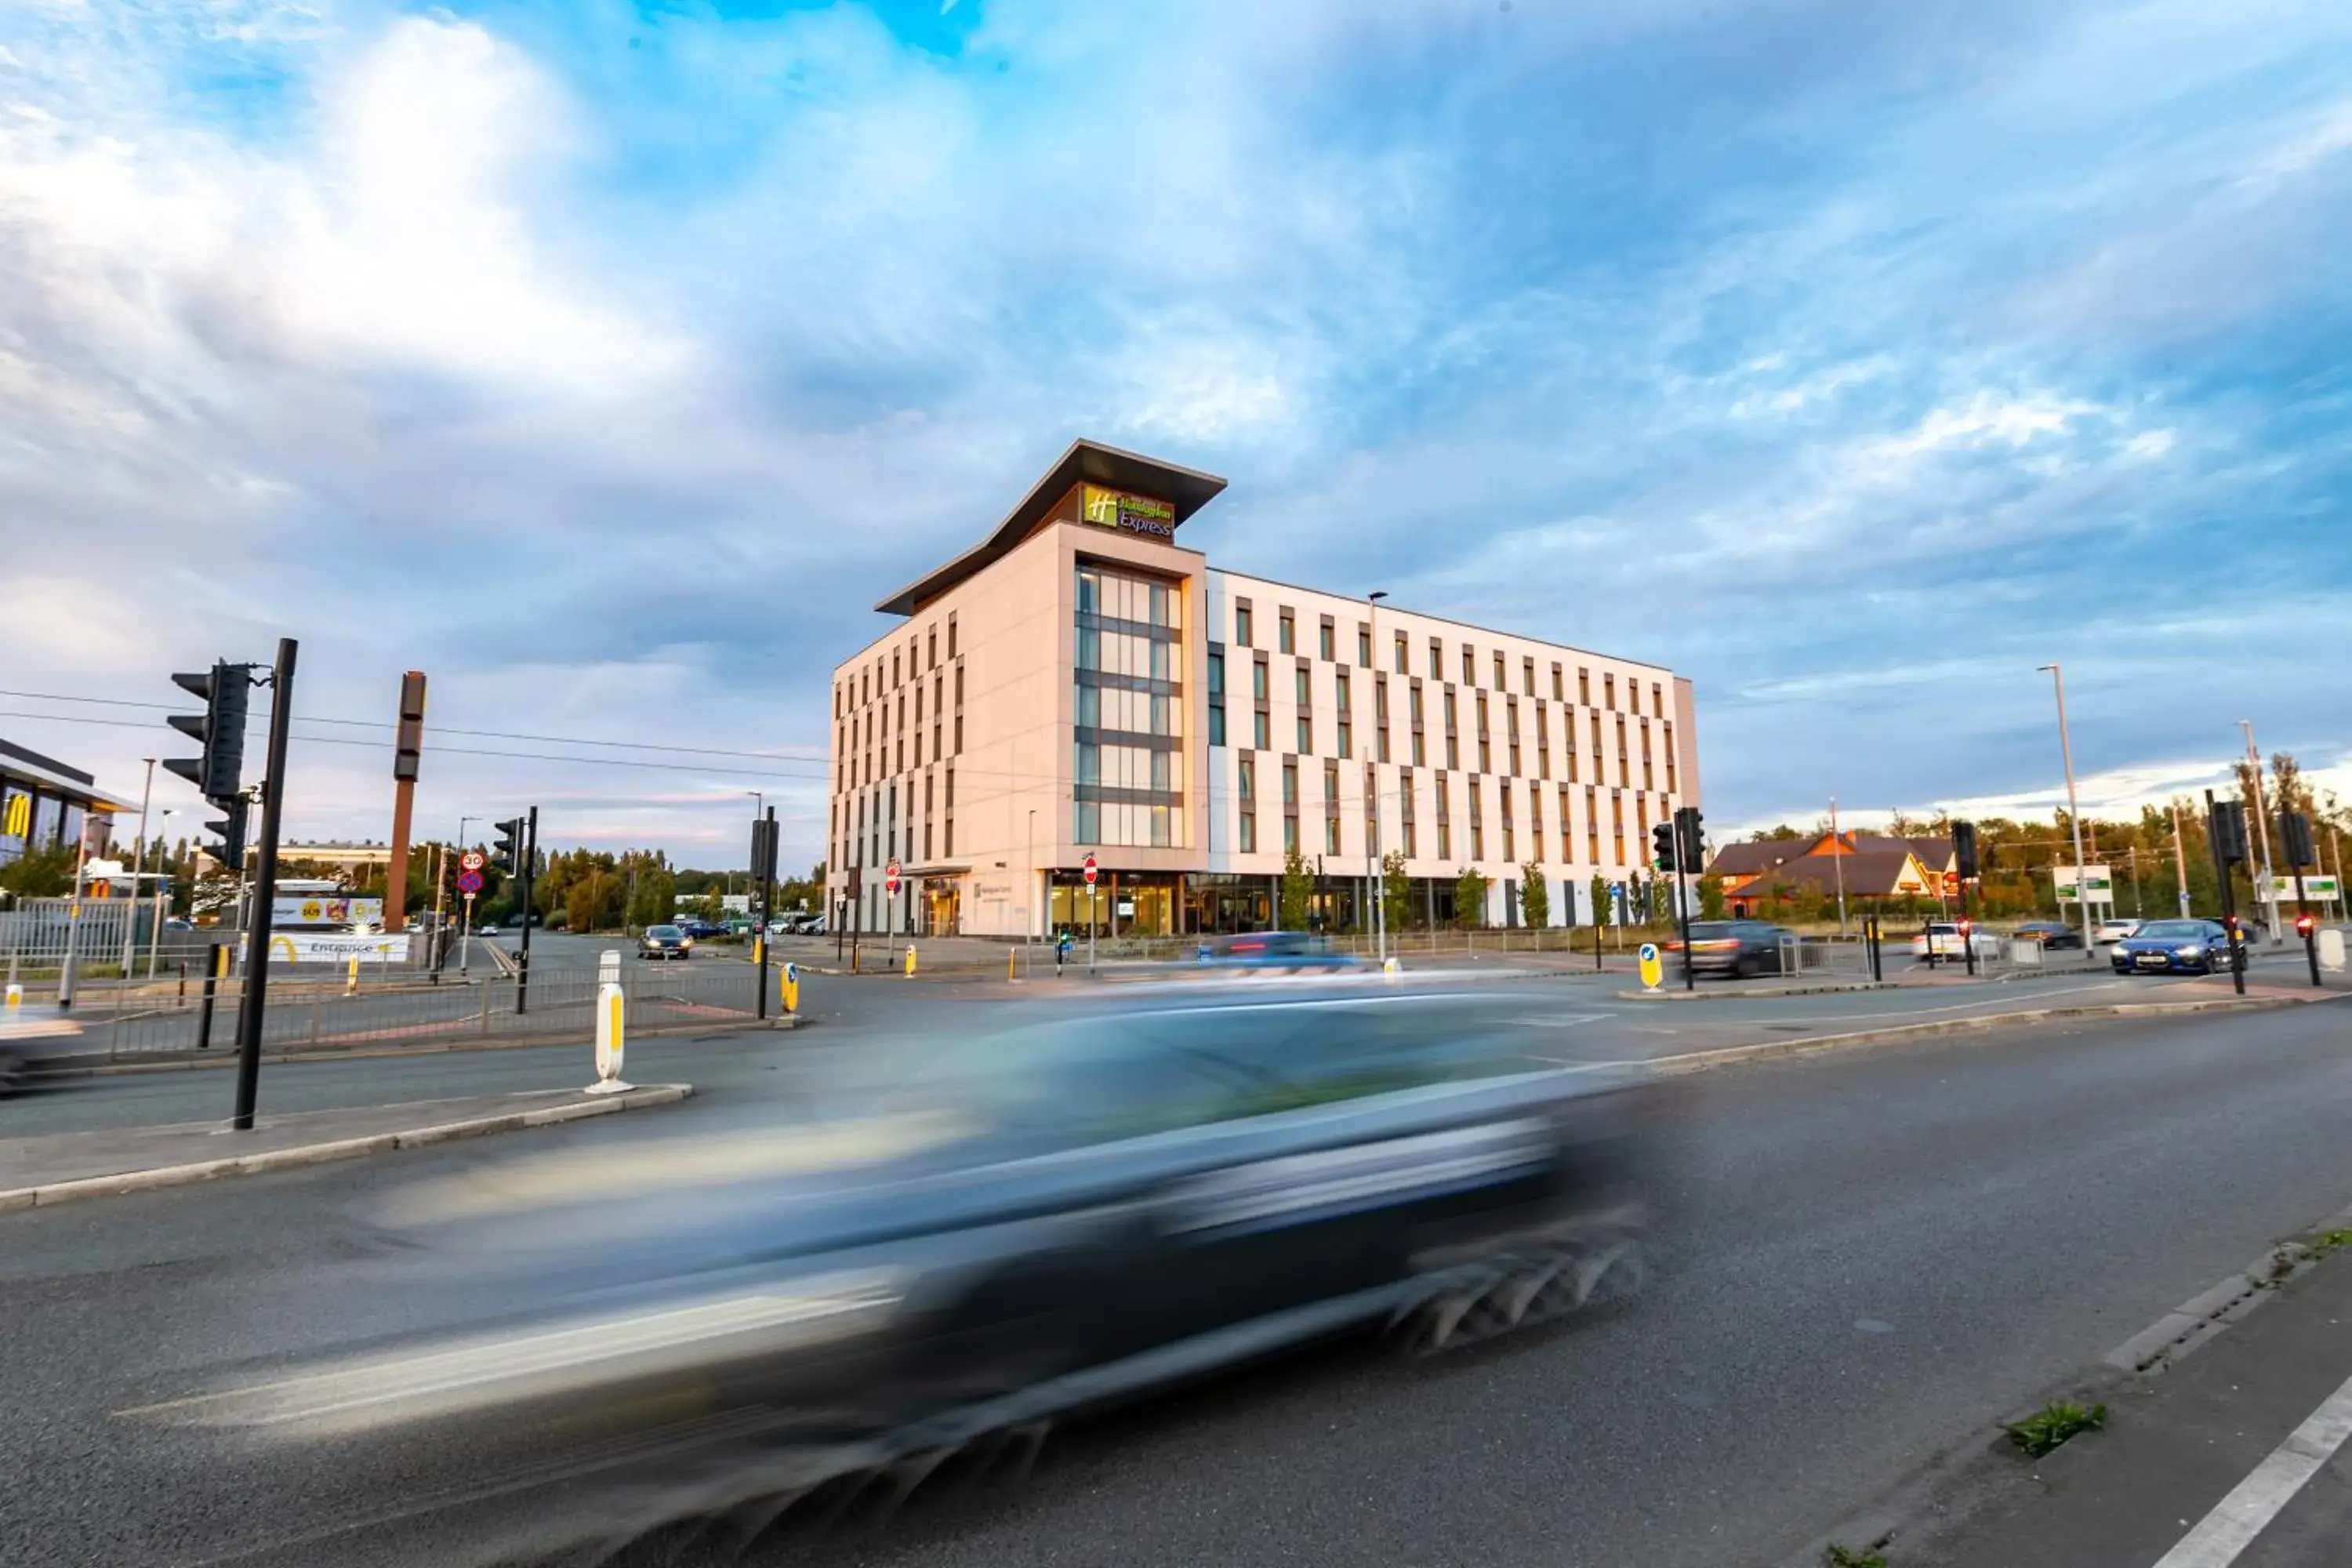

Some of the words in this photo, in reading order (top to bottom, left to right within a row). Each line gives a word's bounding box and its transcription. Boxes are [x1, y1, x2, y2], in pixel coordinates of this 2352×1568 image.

[1120, 511, 1171, 535] Express
[465, 855, 482, 865] 30
[310, 942, 373, 953] Entrance
